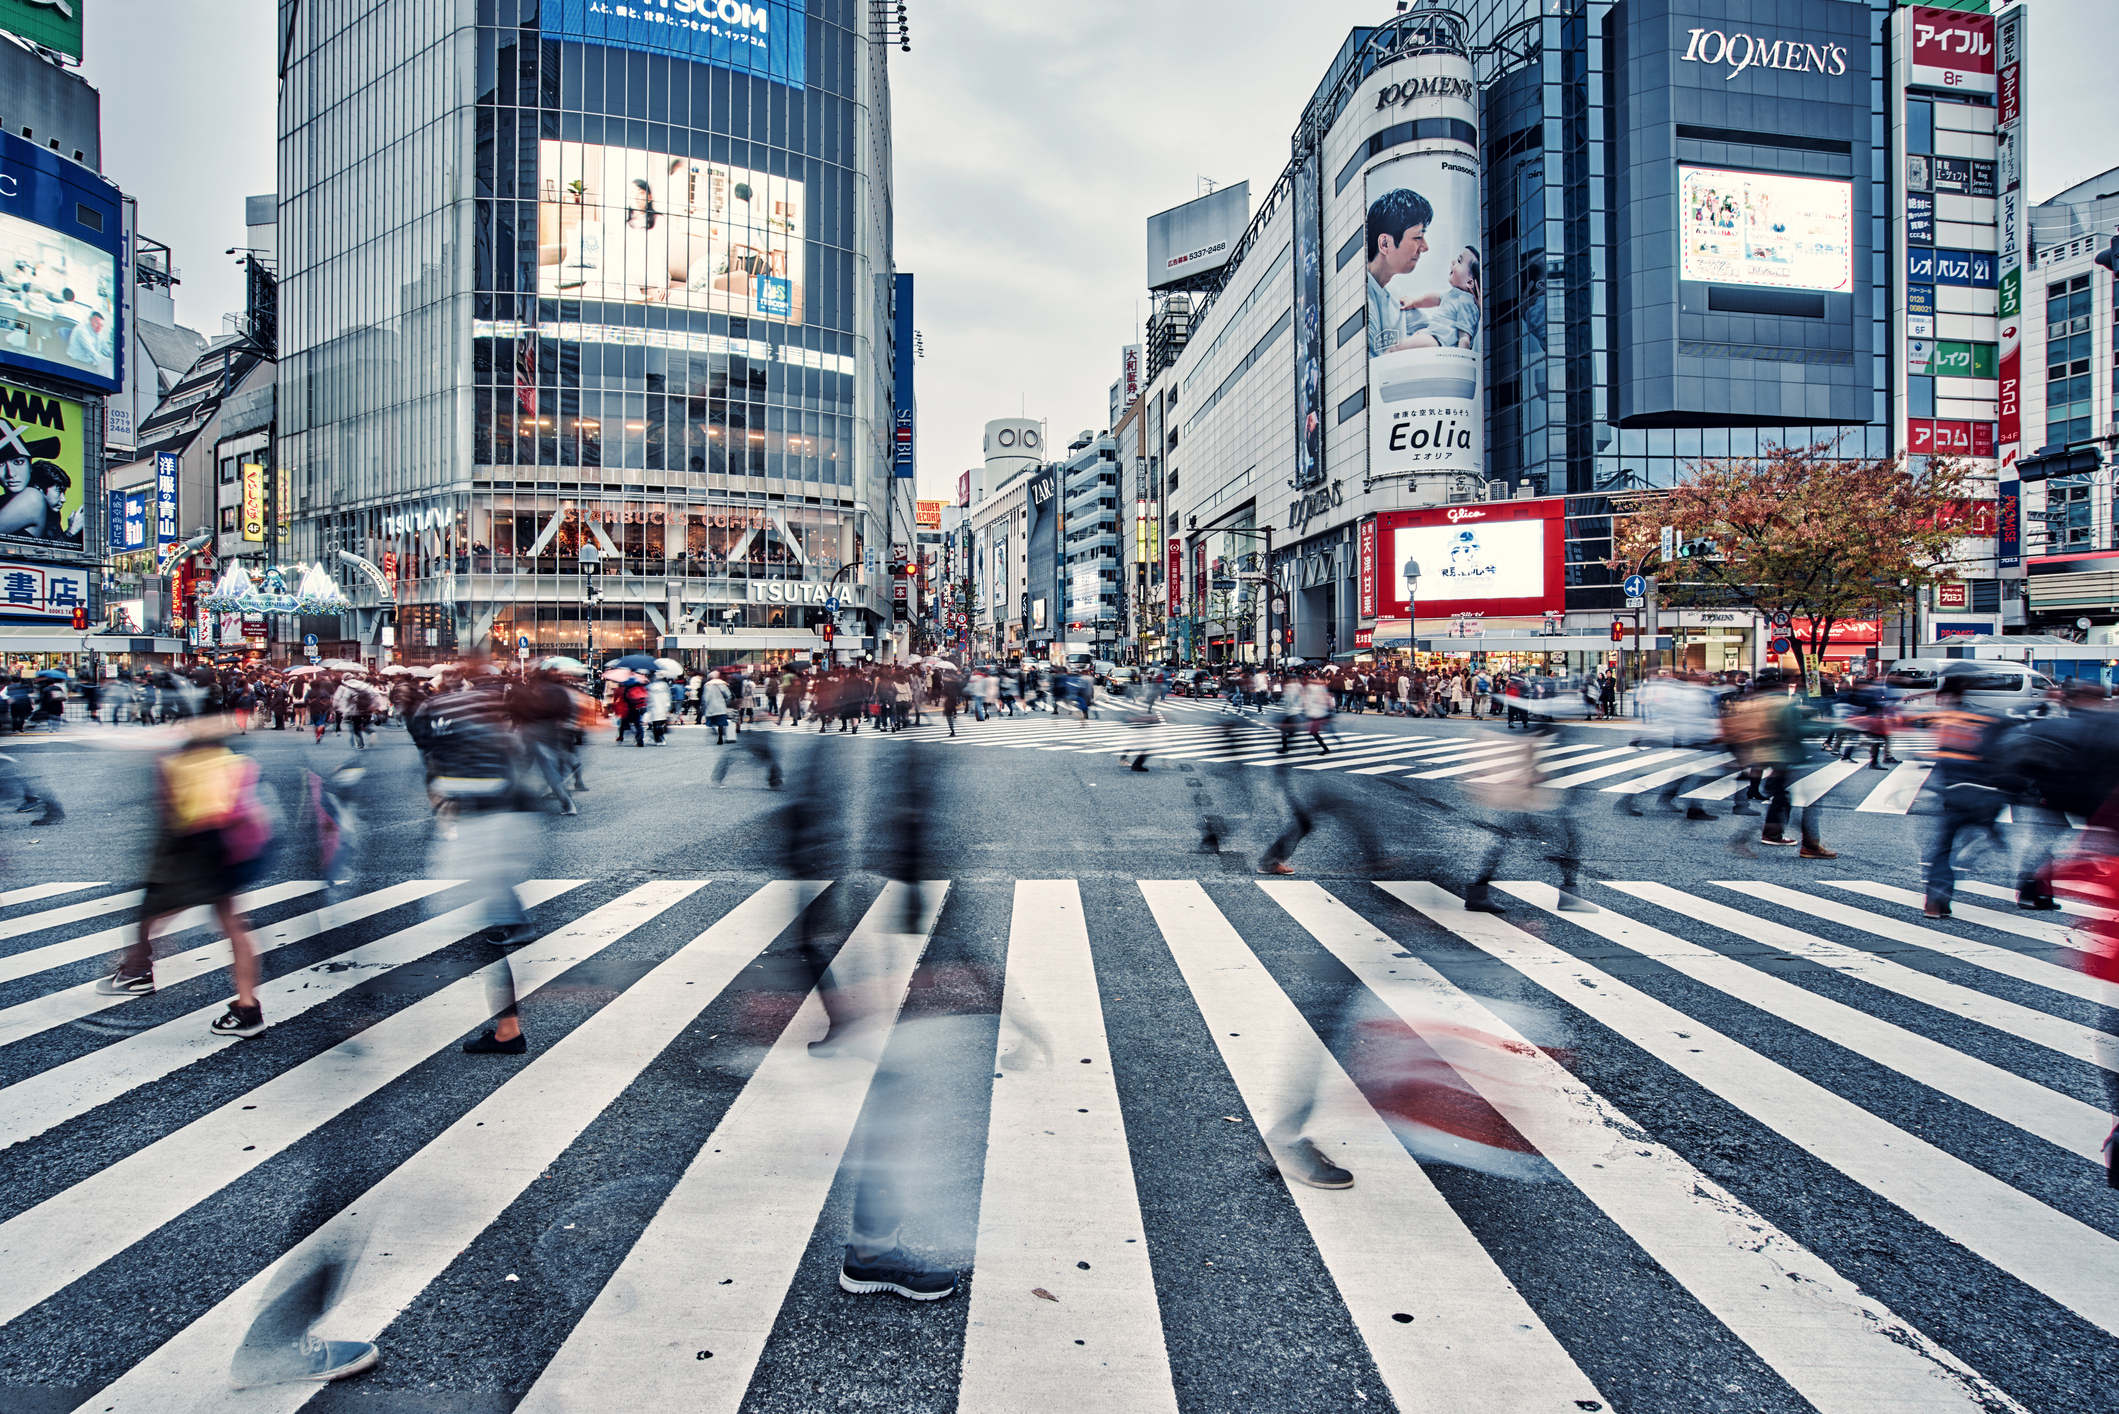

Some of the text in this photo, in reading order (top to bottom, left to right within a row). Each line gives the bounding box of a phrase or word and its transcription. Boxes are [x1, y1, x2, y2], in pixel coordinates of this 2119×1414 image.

[1915, 24, 1992, 56] アイフル
[1943, 71, 1963, 86] 8F
[2003, 78, 2016, 121] アイフル
[1442, 162, 1476, 177] Panasonic
[1973, 180, 1993, 188] Jewelry
[1908, 198, 1932, 209] 絶対に
[1168, 242, 1226, 267] 広告募集 5337-2468
[1909, 295, 1924, 303] 0120
[2003, 278, 2017, 313] レイク
[1909, 304, 1932, 313] 008021
[1915, 326, 1925, 334] 6F
[1937, 350, 1970, 366] レイク
[2002, 379, 2017, 416] アコム
[111, 409, 129, 419] (03)
[110, 418, 130, 426] 3719
[110, 425, 131, 433] 2468
[897, 409, 911, 464] SEIBU
[1389, 420, 1471, 451] Eolia
[1915, 428, 1969, 446] アコム
[1413, 452, 1453, 461] エオリア
[159, 457, 176, 536] 洋服の青山
[917, 502, 940, 512] TOWER
[386, 507, 451, 535] TSUTAYA
[564, 509, 772, 530] STARBUCKS COFFEE
[916, 512, 941, 522] RECORD
[1447, 508, 1486, 523] Glico
[2004, 495, 2016, 543] PROMISE
[248, 524, 259, 533] 4F
[1364, 537, 1372, 613] 天津甘栗
[3, 572, 78, 607] 書店
[753, 582, 852, 604] TSUTAYA
[1941, 593, 1963, 602] プロミス
